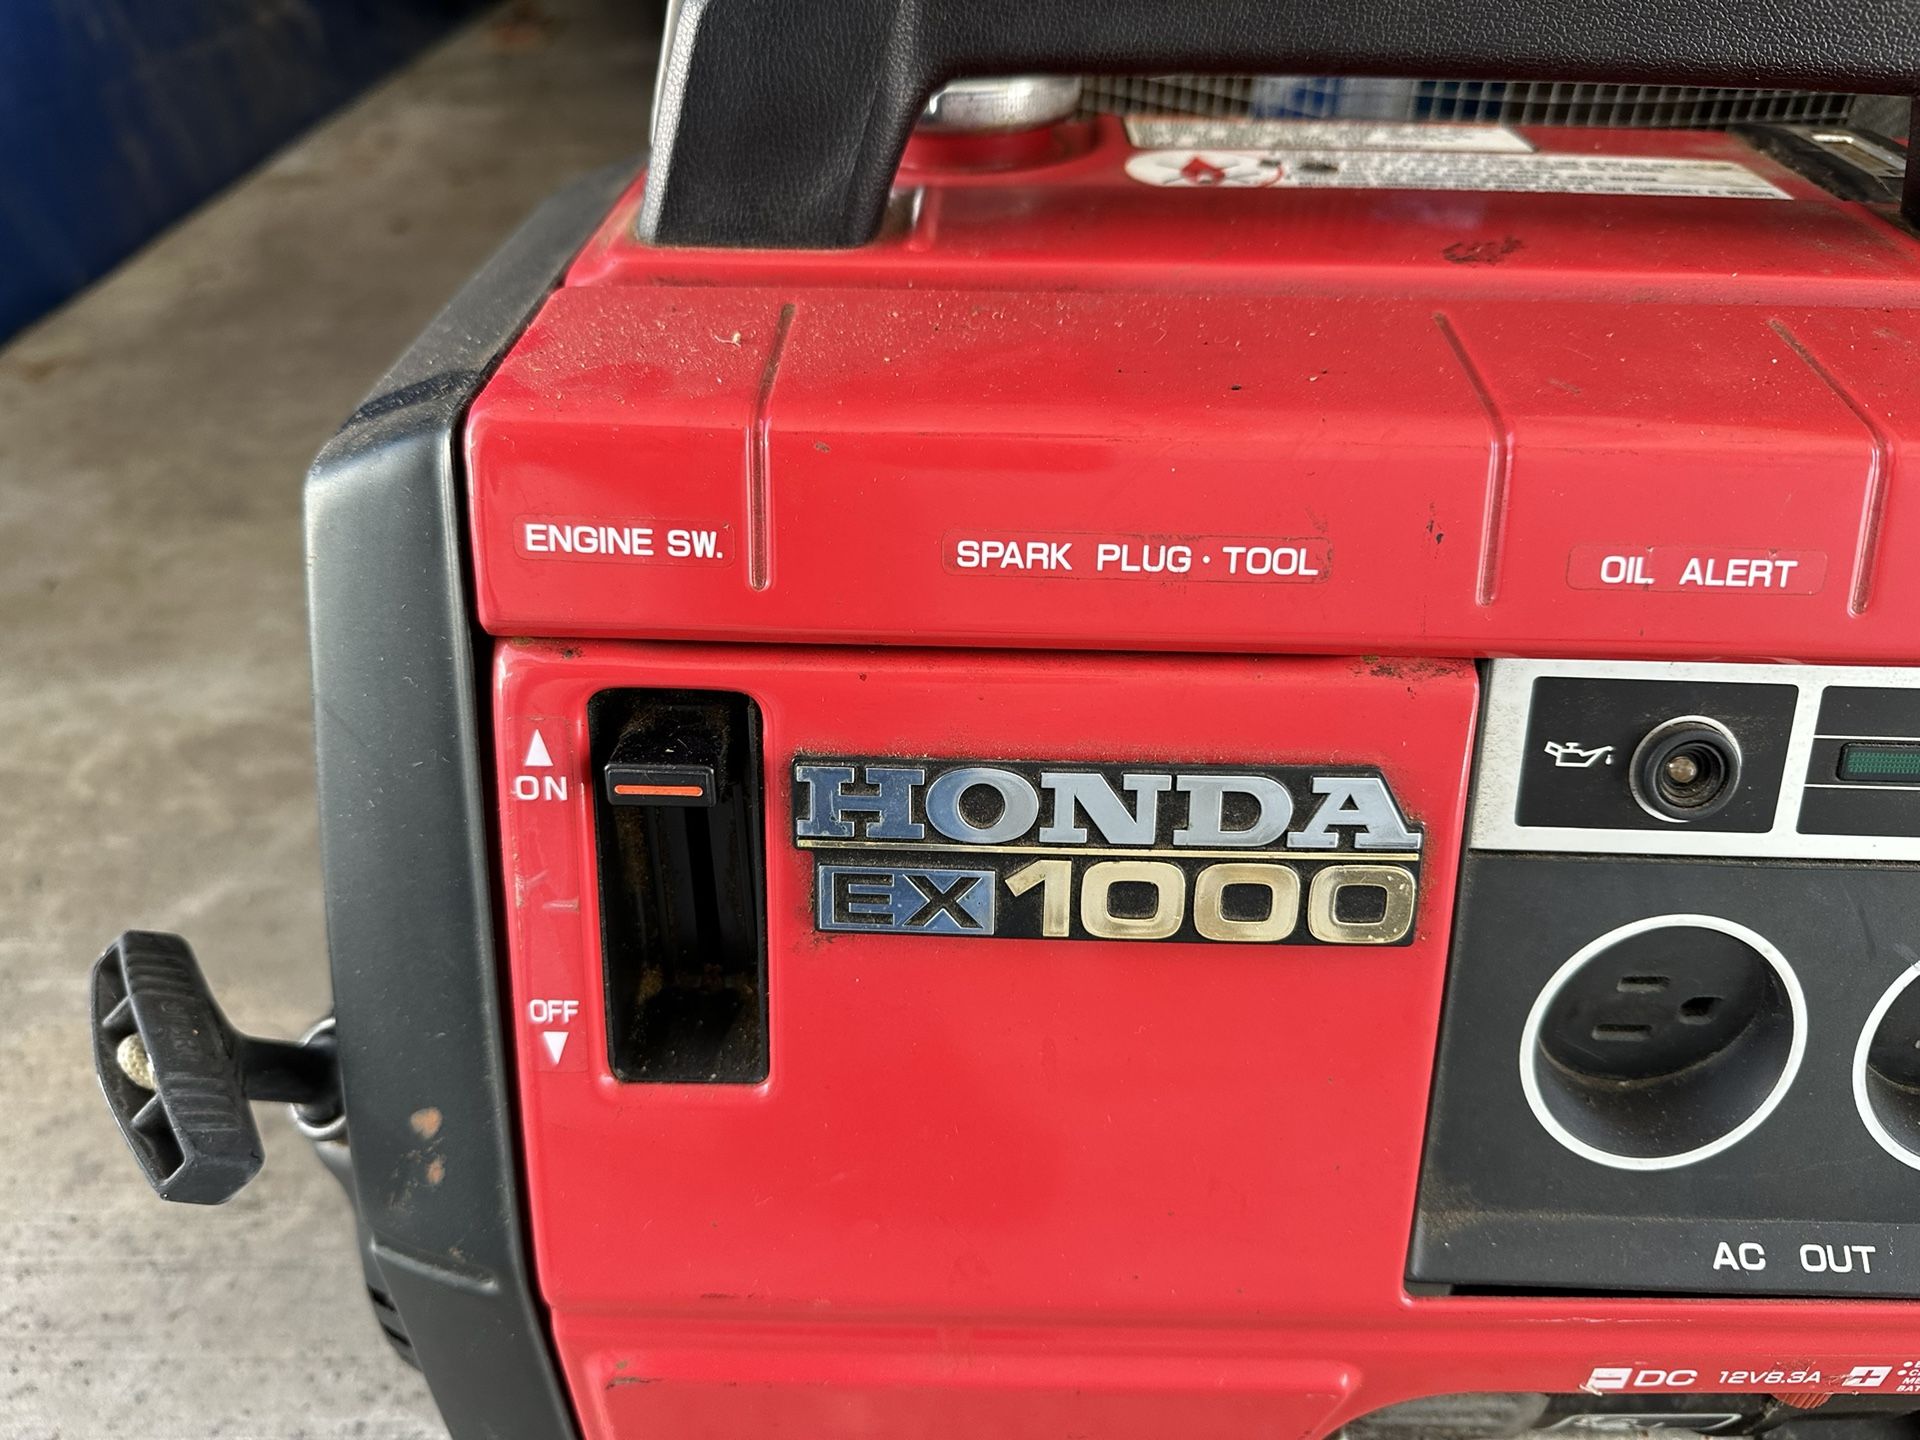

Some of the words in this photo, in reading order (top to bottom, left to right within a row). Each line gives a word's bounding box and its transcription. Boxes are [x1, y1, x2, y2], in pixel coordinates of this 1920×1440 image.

[524, 523, 654, 556] ENGINE
[667, 529, 723, 559] SW.
[956, 540, 1073, 570] SPARK
[1096, 543, 1192, 573] PLUG
[1222, 546, 1319, 576] TOOL
[1600, 555, 1655, 585] OIL
[1678, 554, 1799, 588] ALERT
[511, 775, 568, 801] ON
[796, 765, 1423, 850] HONDA
[527, 998, 579, 1023] OFF
[1712, 1241, 1767, 1271] AC
[1799, 1243, 1876, 1274] OUT
[1633, 1369, 1698, 1387] DC
[1719, 1367, 1821, 1384] 12V8.3A
